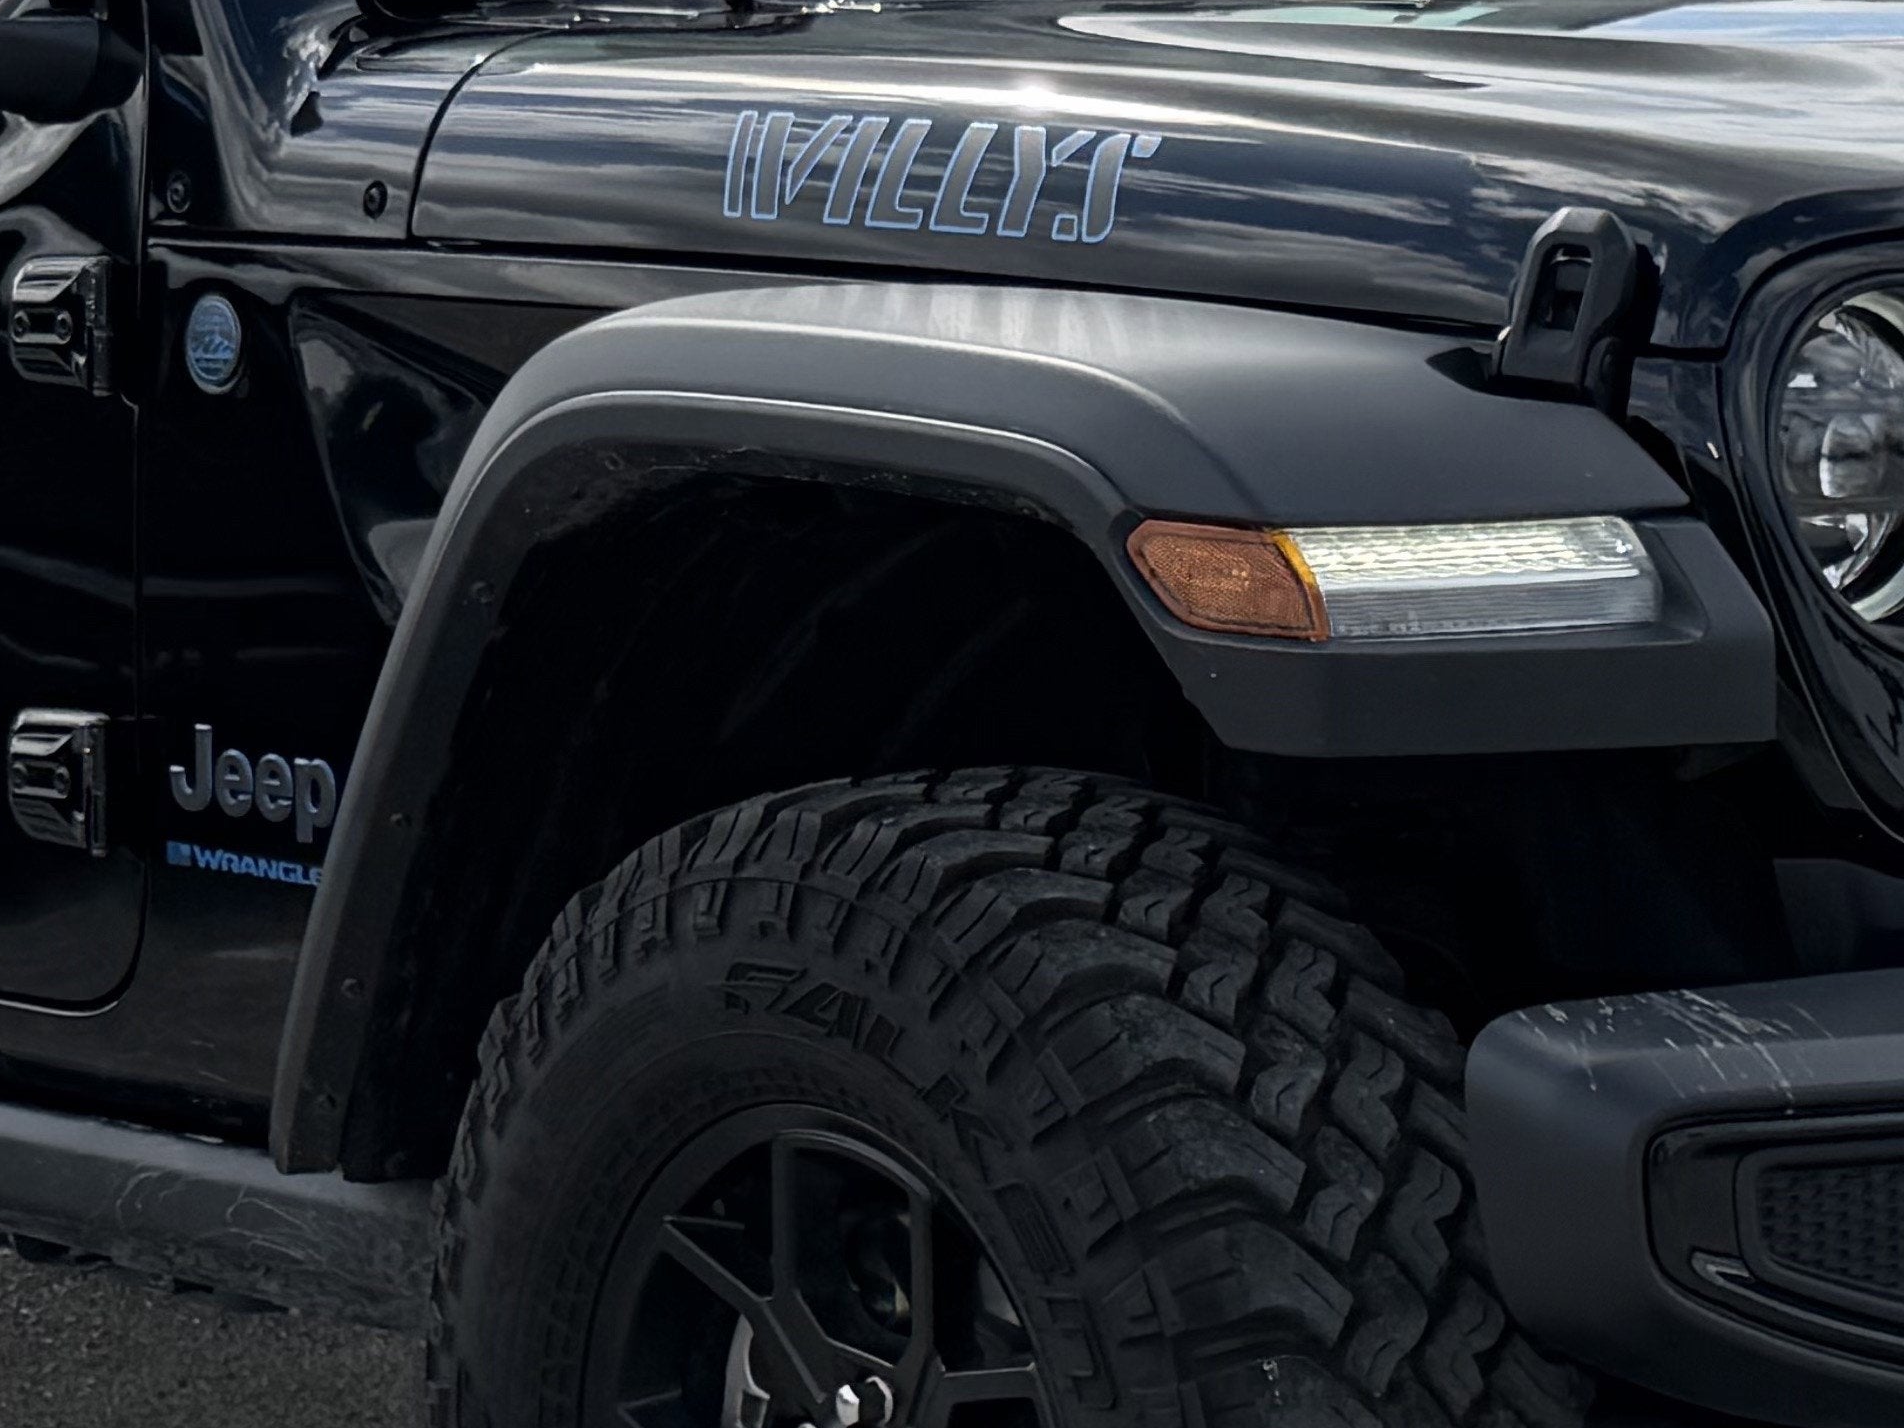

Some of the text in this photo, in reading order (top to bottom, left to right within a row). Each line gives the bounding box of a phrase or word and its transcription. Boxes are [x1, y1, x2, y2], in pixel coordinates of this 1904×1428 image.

[723, 109, 1162, 243] WILLYS
[168, 723, 337, 843] Jeep
[193, 844, 323, 886] WRANGLE
